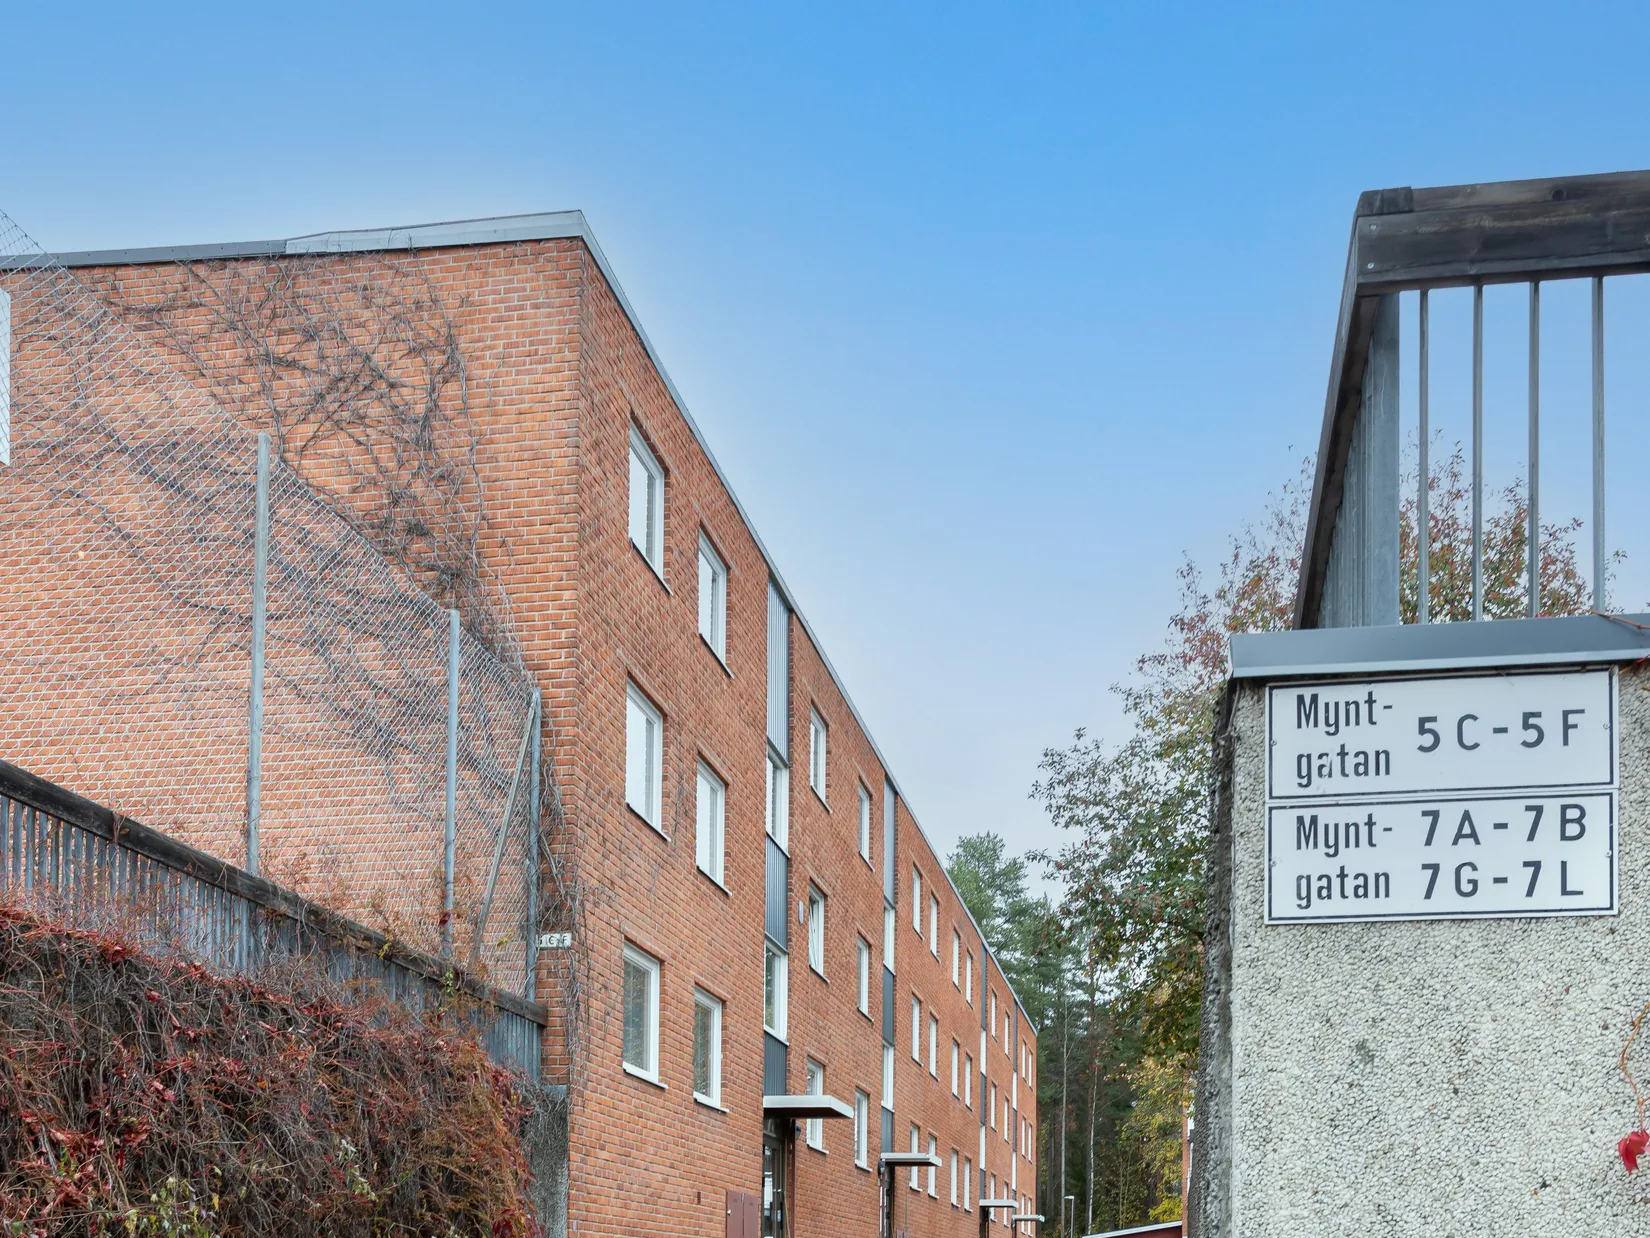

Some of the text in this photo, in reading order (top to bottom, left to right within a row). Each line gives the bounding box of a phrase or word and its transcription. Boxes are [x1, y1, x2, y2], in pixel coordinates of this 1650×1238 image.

[1296, 691, 1393, 736] Mynt-
[1296, 744, 1391, 788] gatan
[1296, 813, 1393, 858] Mynt-
[1296, 865, 1391, 910] gatan
